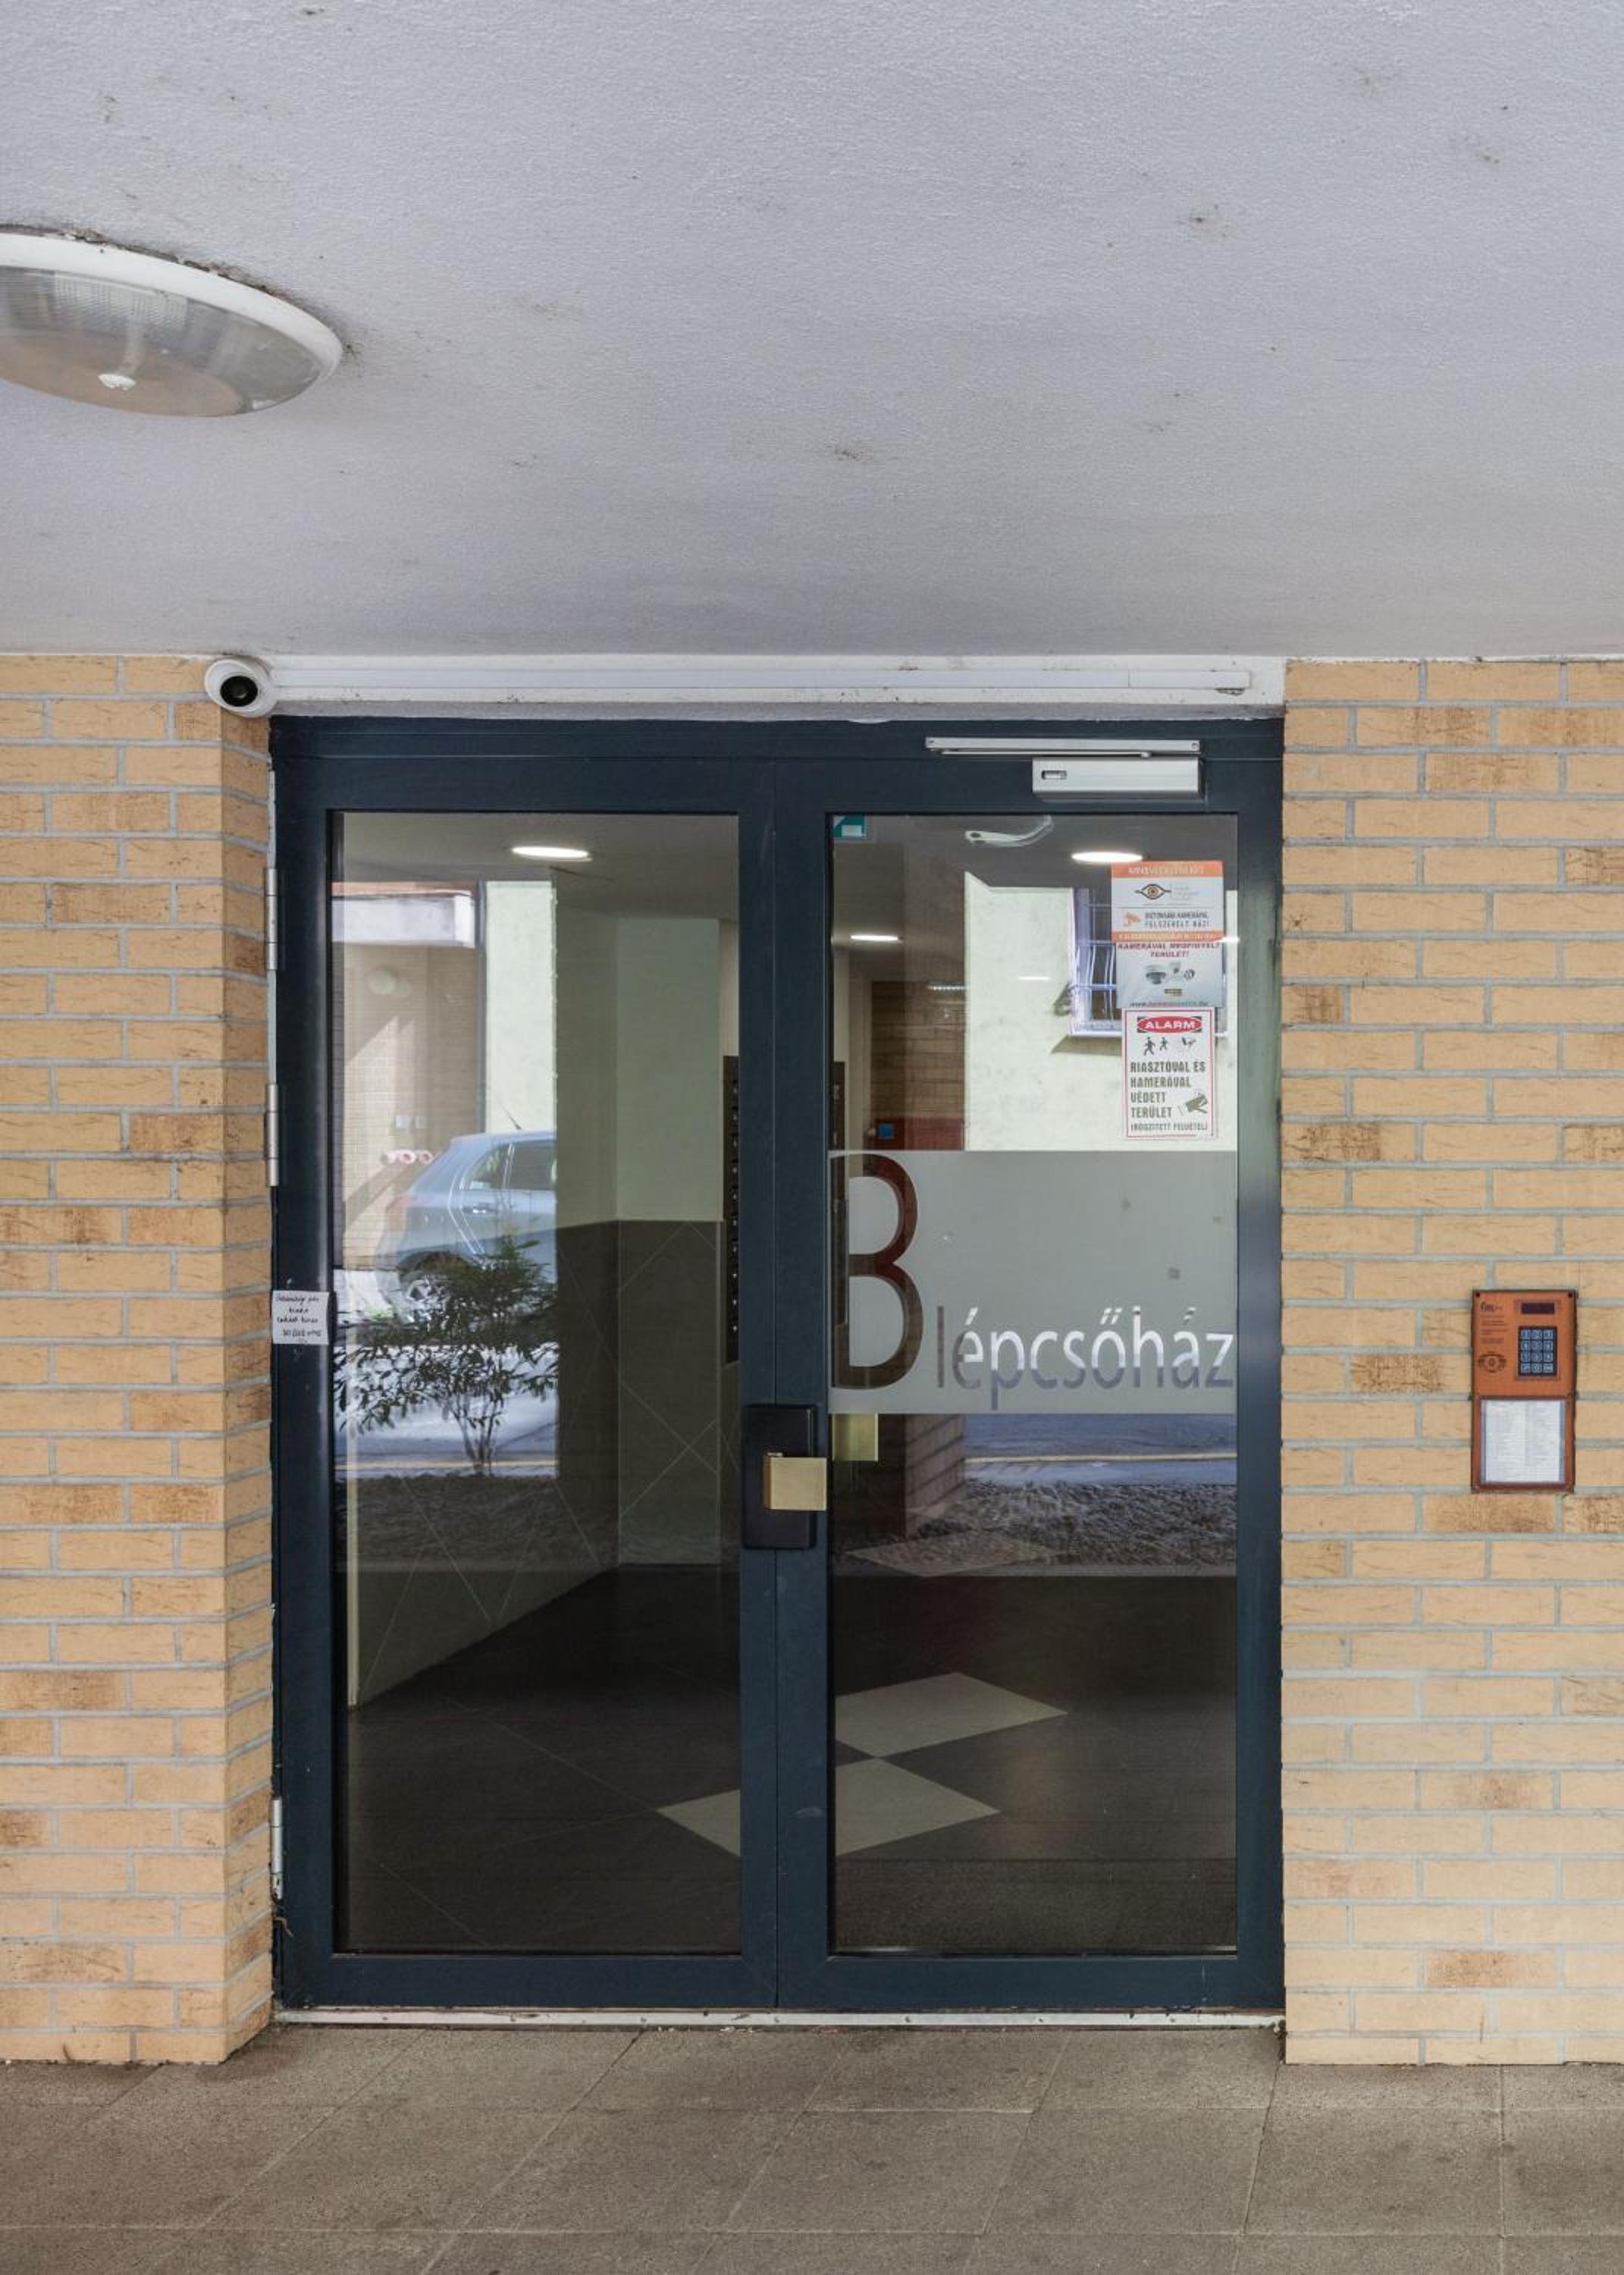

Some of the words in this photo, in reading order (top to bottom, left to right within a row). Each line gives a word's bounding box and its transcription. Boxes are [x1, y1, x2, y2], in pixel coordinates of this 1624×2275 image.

[1144, 1021, 1196, 1029] ALARM
[1130, 1059, 1190, 1072] RIASZTÓVAL
[1193, 1059, 1205, 1072] ÉS
[1130, 1090, 1165, 1103] VÉDETT
[1130, 1106, 1172, 1118] TERÜLET
[831, 1153, 923, 1389] B
[937, 1306, 1234, 1410] lépcsőház
